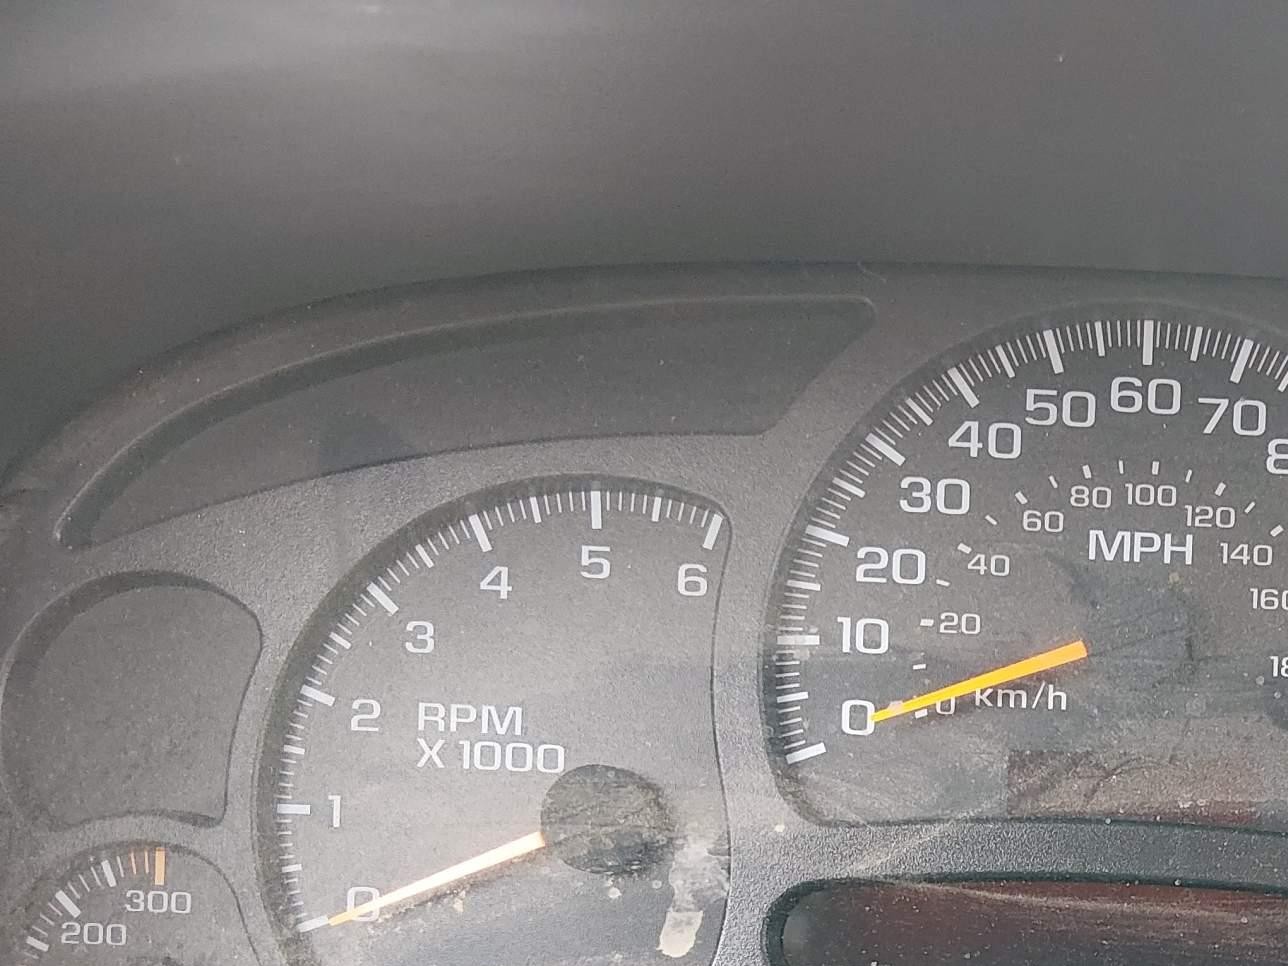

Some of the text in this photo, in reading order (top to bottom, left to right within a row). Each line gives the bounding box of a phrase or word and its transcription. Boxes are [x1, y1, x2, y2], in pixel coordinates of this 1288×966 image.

[1026, 389, 1095, 427] 50
[1111, 377, 1180, 414] 60
[1199, 398, 1266, 435] 70
[949, 421, 1021, 458] 40
[900, 477, 969, 514] 30
[1071, 486, 1111, 507] 80
[1125, 484, 1176, 506] 100
[1023, 510, 1063, 532] 60
[1185, 505, 1235, 528] 120
[581, 546, 610, 578] 5
[1089, 530, 1192, 564] MPH
[1221, 543, 1272, 565] 140
[678, 564, 707, 596] 6
[856, 547, 925, 584] 20
[968, 554, 1009, 576] 40
[480, 566, 512, 599] 4
[406, 621, 434, 653] 3
[838, 617, 888, 653] 10
[940, 613, 980, 634] 20
[974, 681, 1068, 711] km/h
[351, 699, 380, 731] 2
[418, 703, 522, 735] RPM
[841, 699, 875, 736] 0
[417, 738, 565, 774] X 1000
[328, 795, 340, 827] 1
[125, 890, 191, 913] 300
[347, 886, 381, 923] 0
[61, 922, 126, 945] 200
